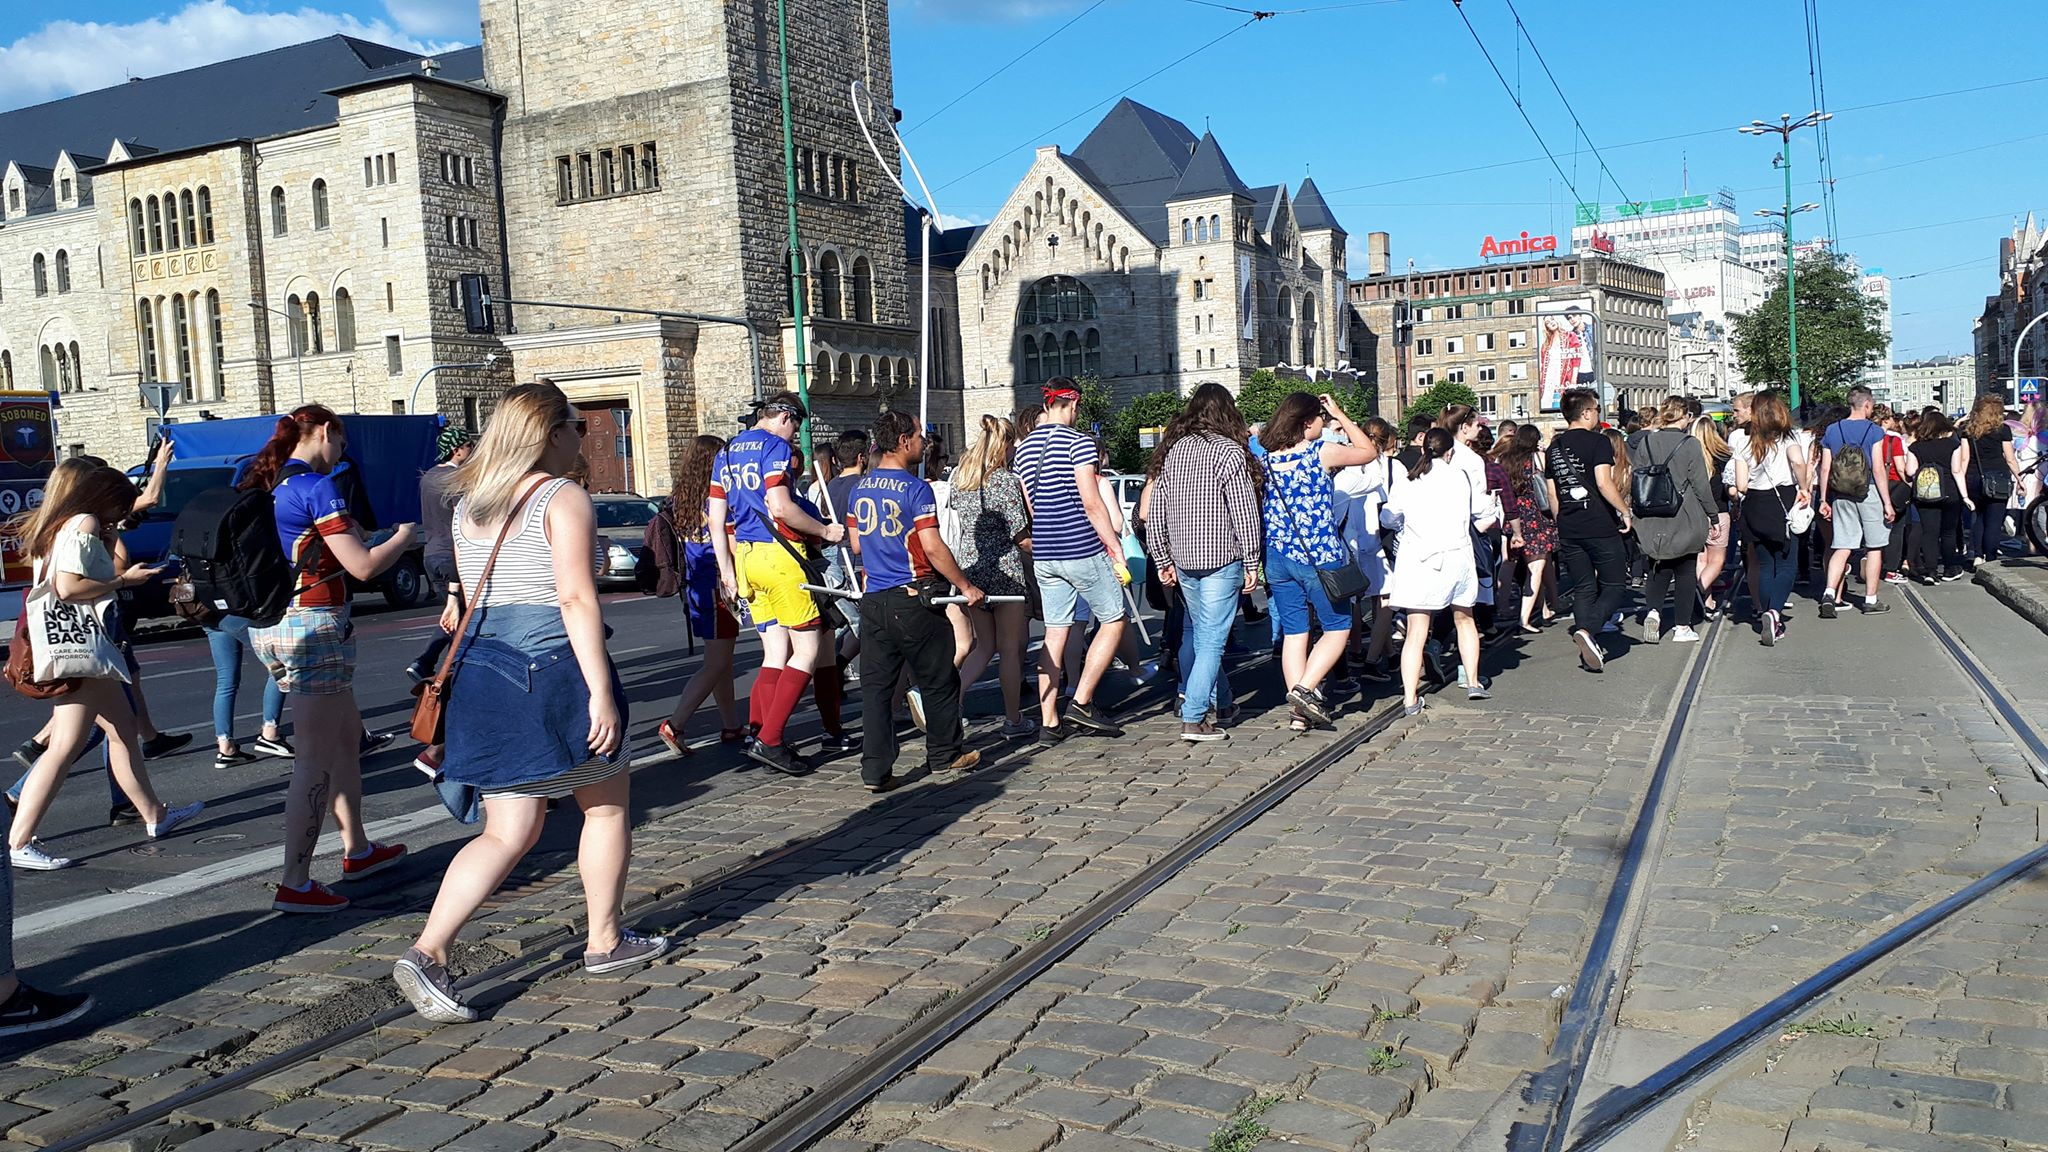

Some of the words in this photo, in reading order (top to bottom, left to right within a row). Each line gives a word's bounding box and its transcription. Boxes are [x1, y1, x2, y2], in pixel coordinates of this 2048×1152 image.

[1480, 231, 1557, 256] Amica
[0, 409, 48, 422] SOBOMED
[854, 497, 904, 537] 93
[54, 600, 78, 615] AM
[43, 610, 78, 622] NOT
[85, 613, 99, 626] A
[45, 621, 100, 635] PLAST
[47, 632, 87, 646] BAG
